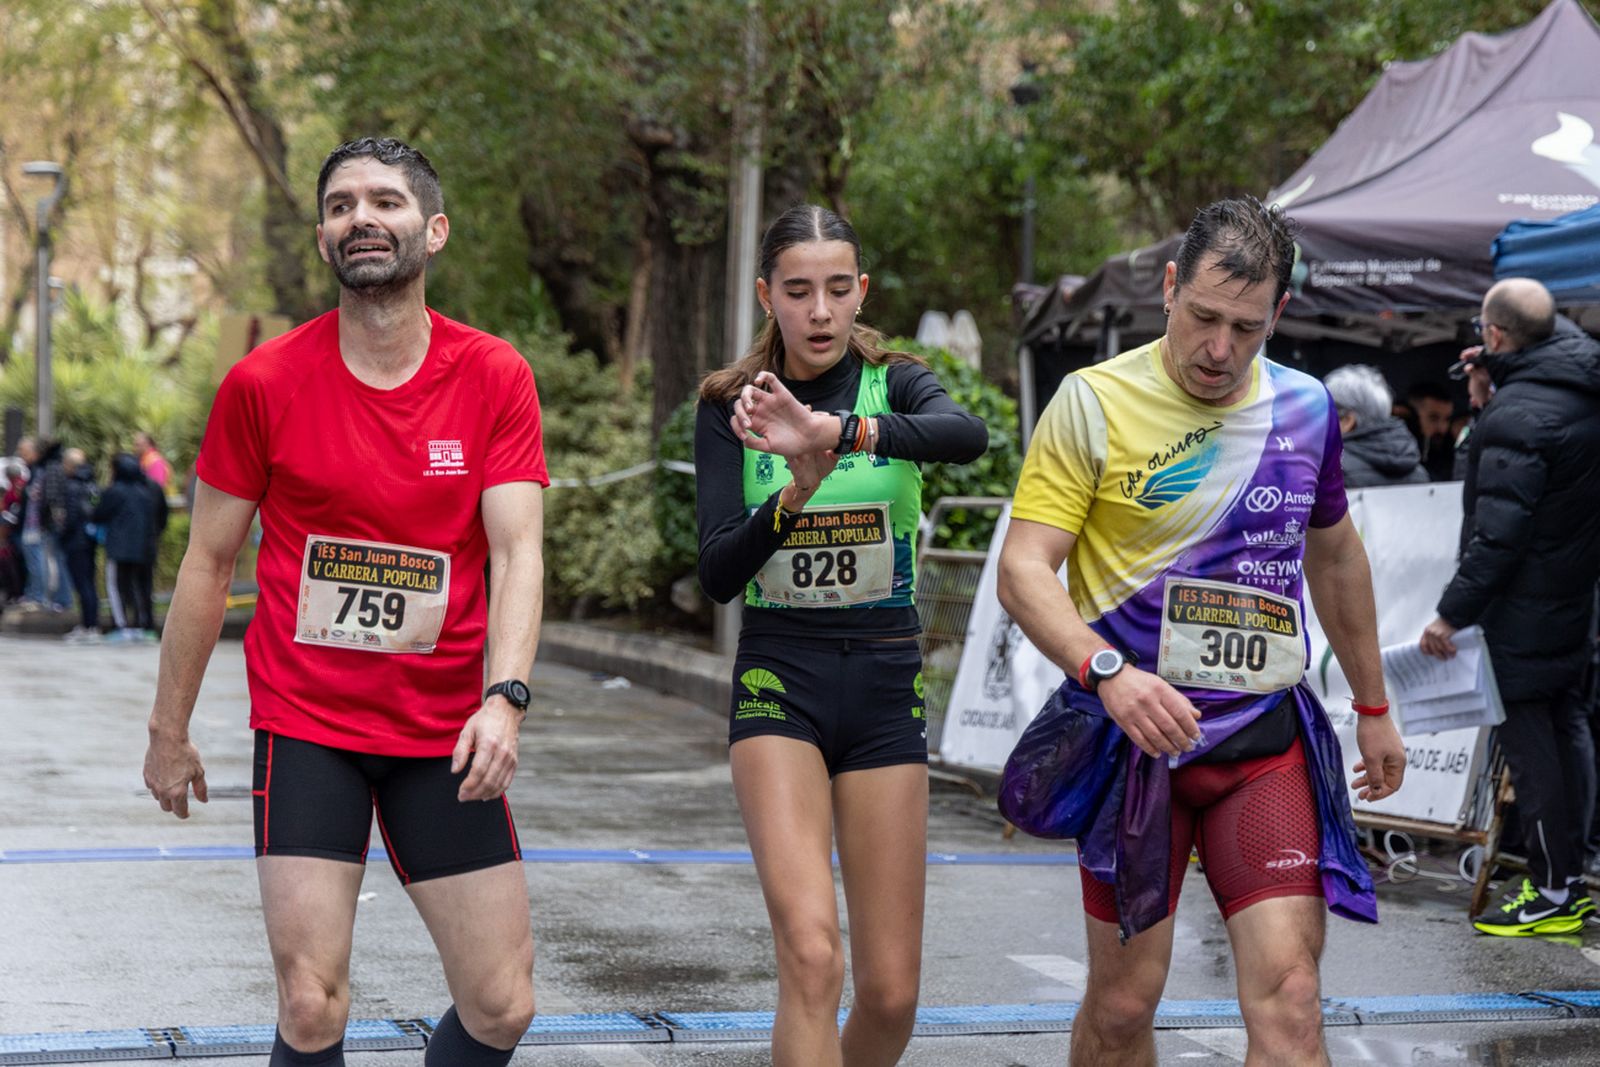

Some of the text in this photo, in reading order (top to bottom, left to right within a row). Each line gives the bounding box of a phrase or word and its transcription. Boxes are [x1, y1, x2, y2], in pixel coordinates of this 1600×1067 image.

[812, 514, 840, 528] Juan
[843, 512, 876, 525] Bosco
[831, 527, 882, 543] POPULAR
[317, 544, 436, 571] IES San Juan Bosco
[791, 549, 857, 589] 828
[313, 561, 438, 590] V CARRERA POPULAR
[334, 586, 406, 631] 759
[1179, 589, 1288, 617] IES San Juan Bosco
[1174, 605, 1294, 634] V CARRERA POPULAR
[1200, 629, 1268, 672] 300
[739, 698, 781, 712] Unicaja
[1424, 749, 1441, 771] DE
